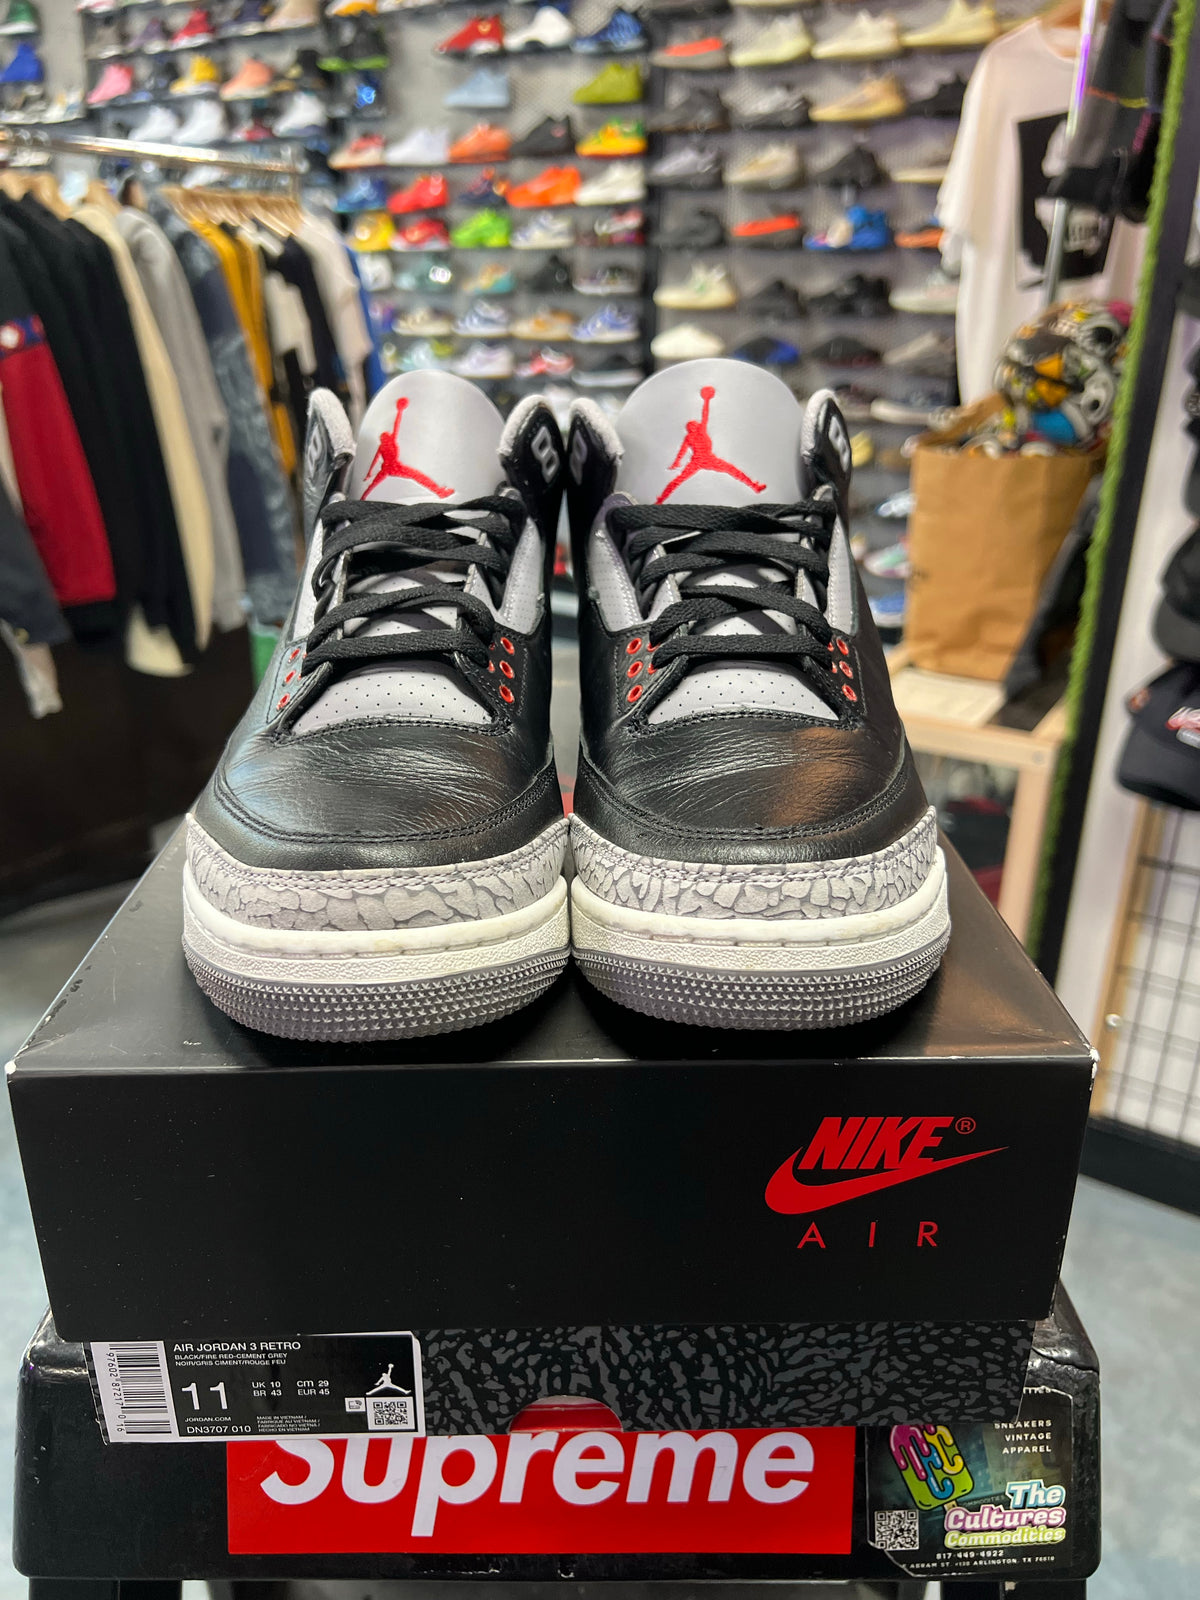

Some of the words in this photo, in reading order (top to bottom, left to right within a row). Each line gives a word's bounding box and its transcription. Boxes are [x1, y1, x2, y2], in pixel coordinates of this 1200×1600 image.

[797, 1116, 955, 1170] NIKE
[796, 1221, 939, 1249] AIR
[173, 1343, 194, 1352] AIR
[196, 1342, 247, 1352] JORDAN
[249, 1342, 257, 1351] 3
[260, 1341, 302, 1351] RETRO
[106, 1352, 119, 1378] 97602
[251, 1381, 266, 1389] UK
[297, 1388, 317, 1396] EUR
[318, 1388, 330, 1396] 45
[111, 1382, 124, 1406] 87217
[253, 1389, 267, 1397] BR
[270, 1389, 282, 1397] 43
[186, 1425, 230, 1434] DN3707
[231, 1425, 252, 1434] 010
[994, 1419, 1052, 1429] SNEAKERS
[1005, 1432, 1052, 1442] VINTAGE
[1002, 1445, 1052, 1455] APPAREL
[259, 1431, 815, 1538] Supreme
[1008, 1482, 1064, 1508] The
[946, 1506, 1065, 1530] Cultures
[946, 1527, 1065, 1547] Commodities
